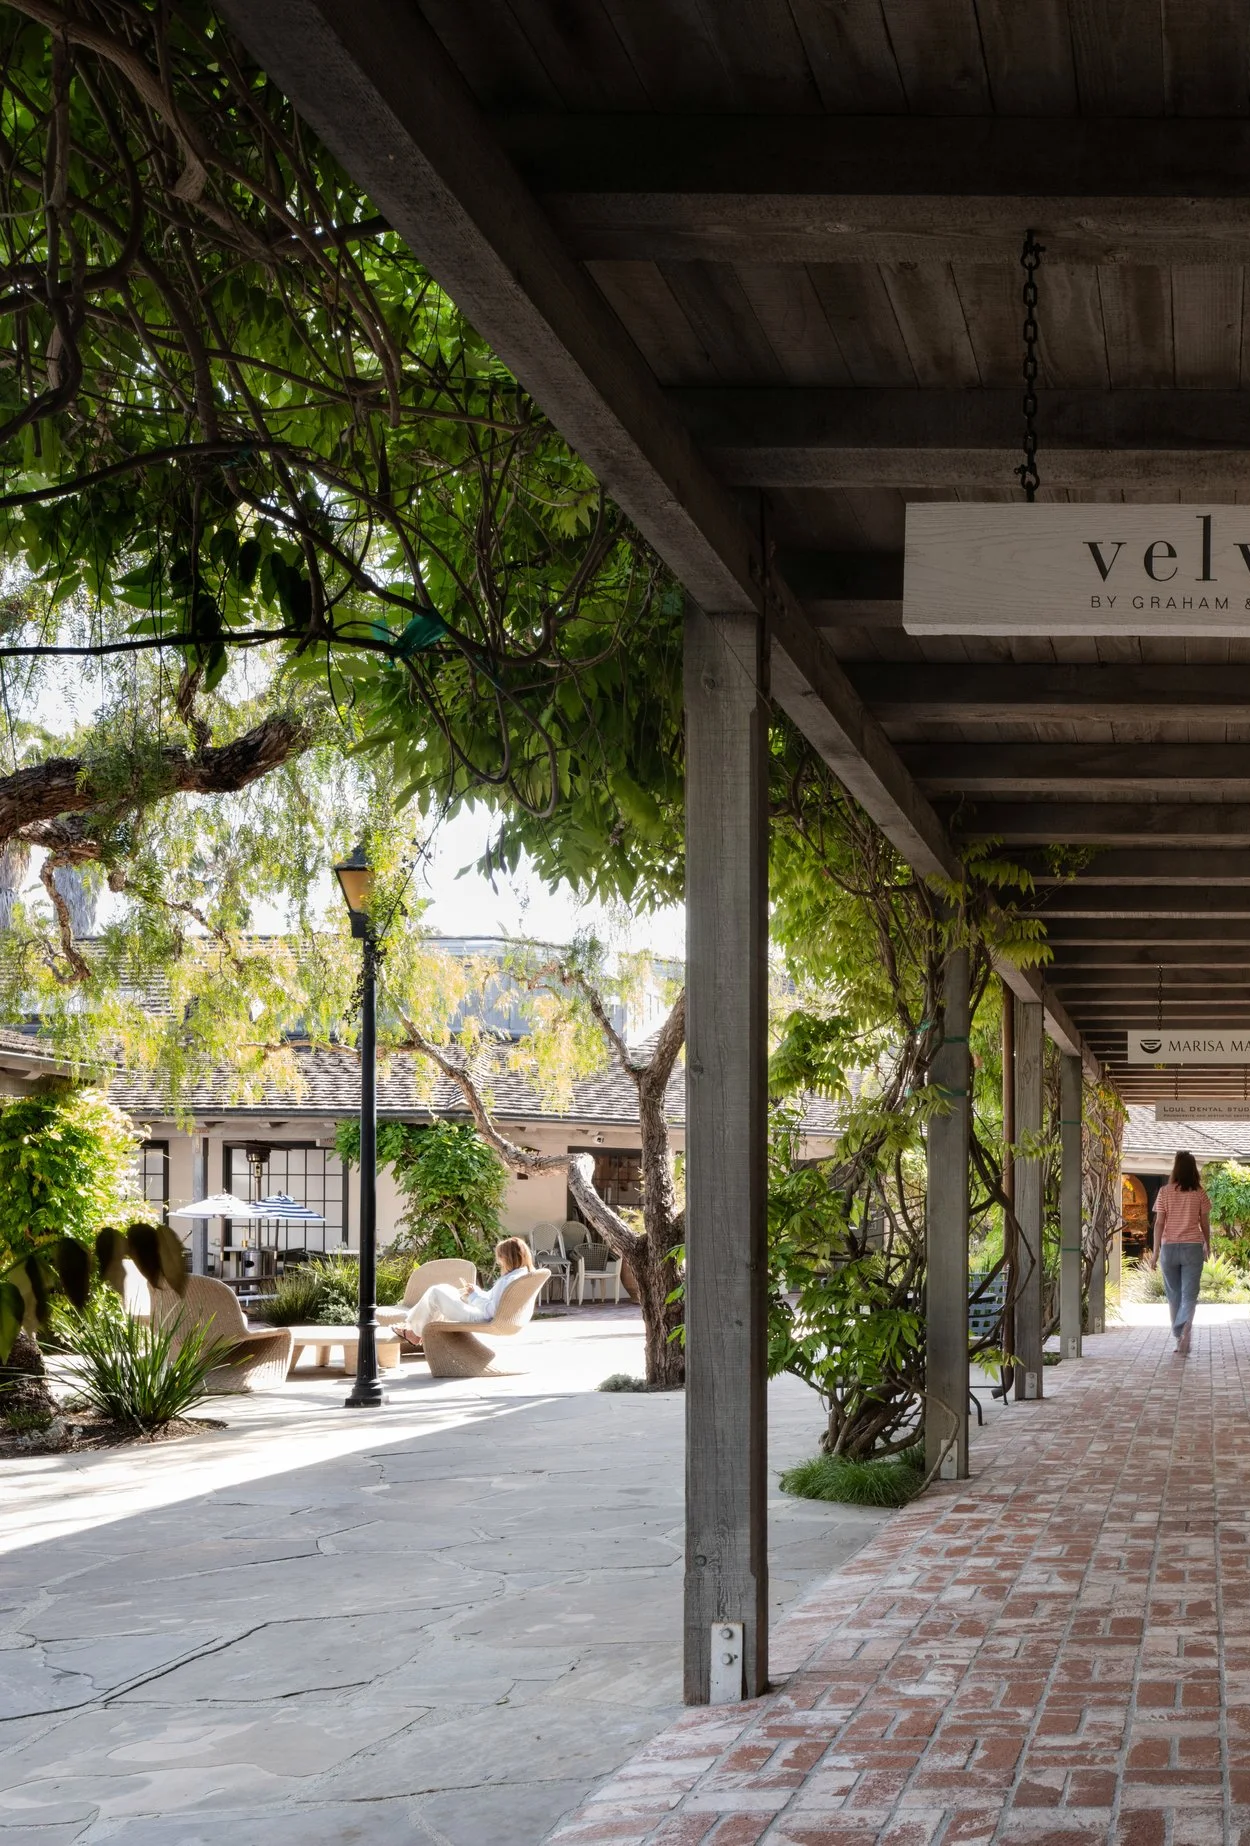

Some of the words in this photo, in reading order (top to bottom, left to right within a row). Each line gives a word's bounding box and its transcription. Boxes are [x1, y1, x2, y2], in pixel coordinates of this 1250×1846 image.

[1090, 595, 1118, 609] BY
[1132, 595, 1229, 610] GRAHAM
[1168, 1040, 1225, 1052] MARISA
